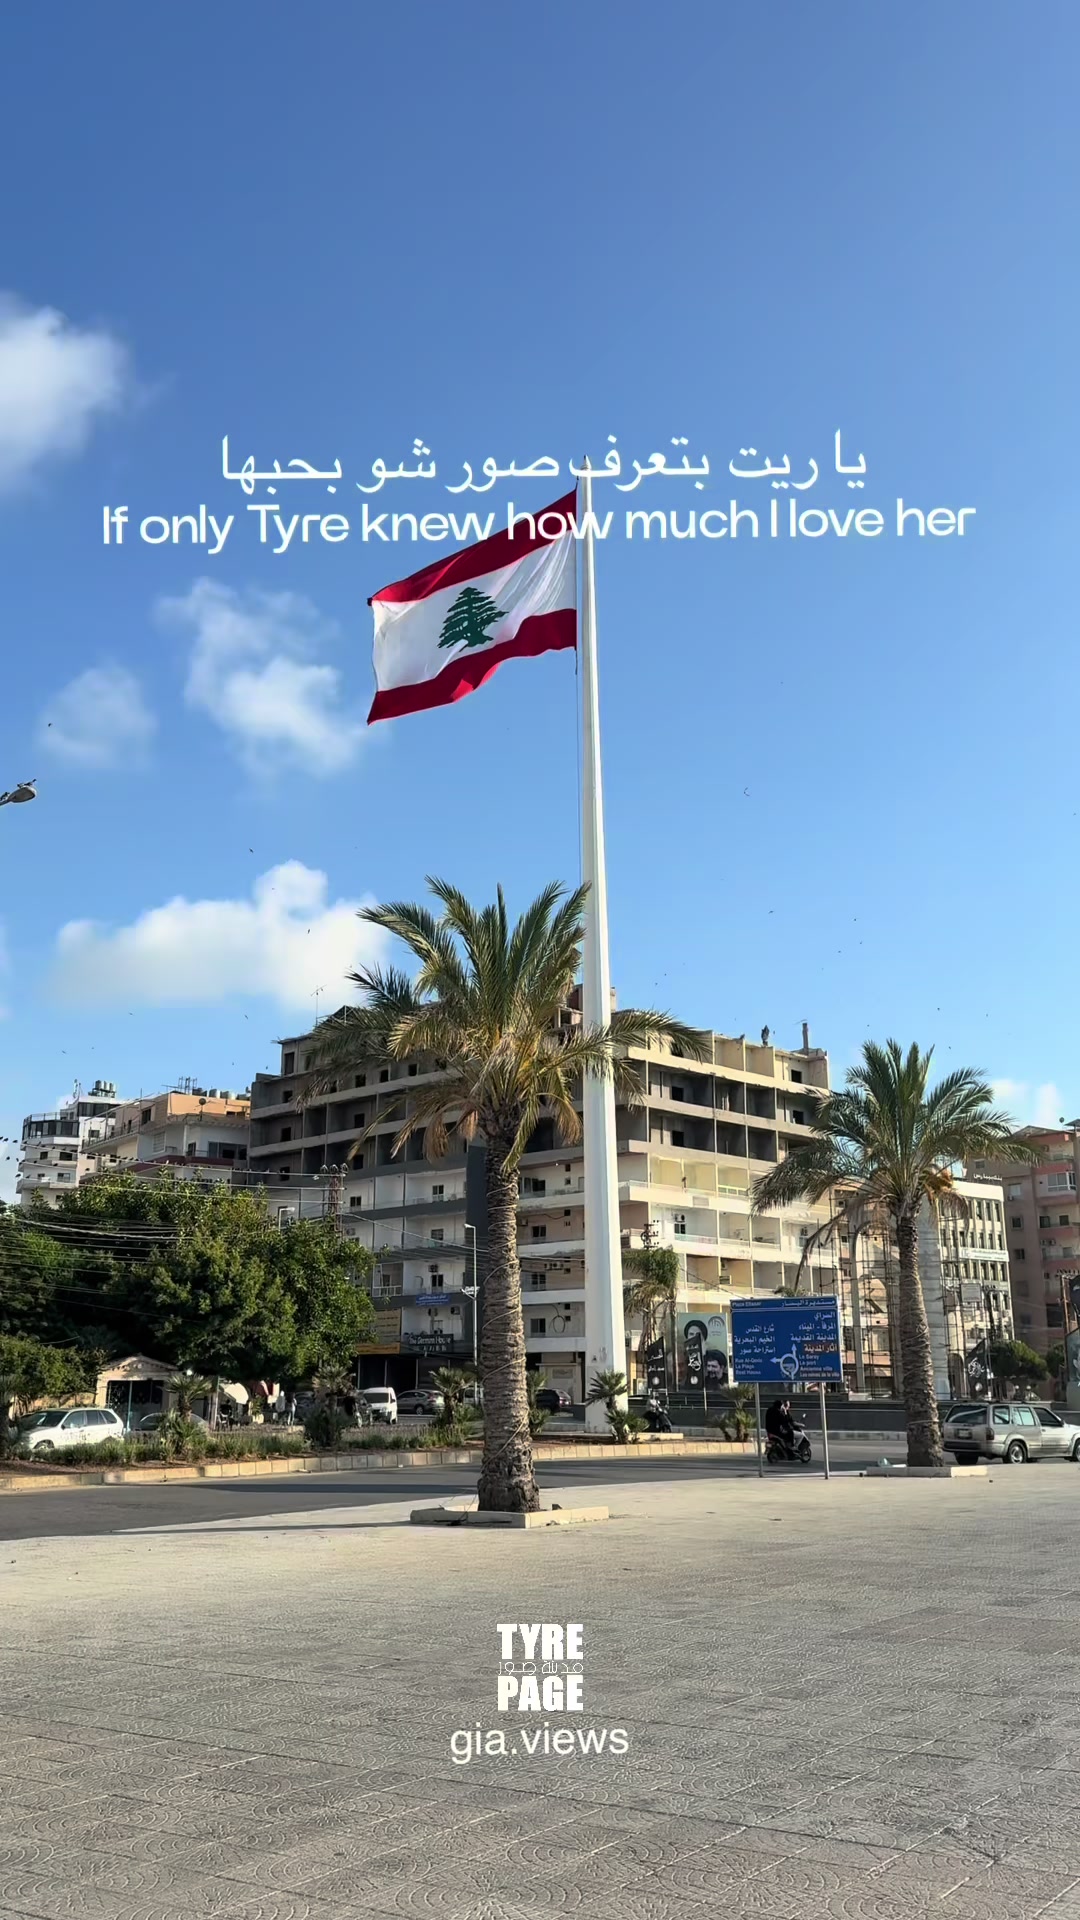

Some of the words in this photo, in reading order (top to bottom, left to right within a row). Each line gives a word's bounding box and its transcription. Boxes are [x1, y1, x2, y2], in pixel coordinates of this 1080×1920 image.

[790, 1333, 815, 1343] القديمة
[816, 1333, 837, 1342] المدينة
[804, 1343, 825, 1353] المدينة
